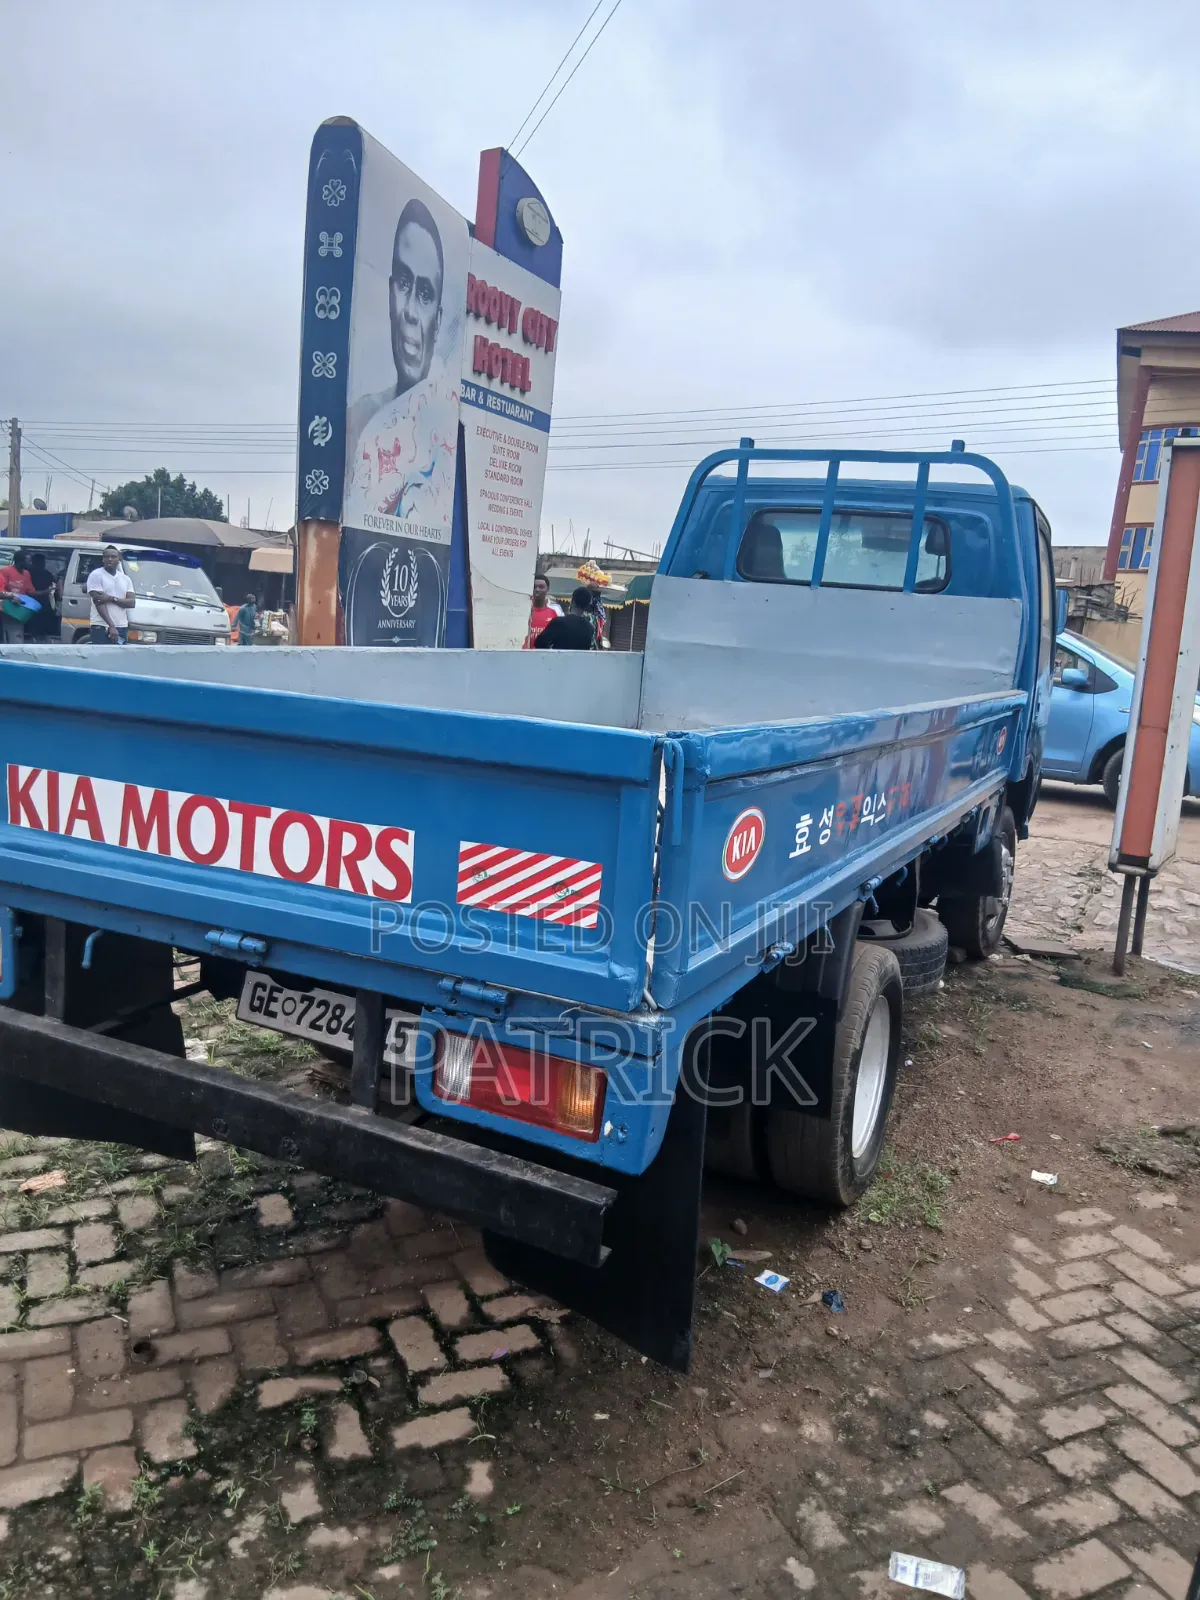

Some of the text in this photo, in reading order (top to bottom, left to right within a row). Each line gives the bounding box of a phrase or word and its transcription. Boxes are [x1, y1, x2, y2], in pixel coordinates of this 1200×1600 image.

[522, 307, 559, 352] CITY
[473, 335, 532, 392] HOTEL
[460, 385, 534, 423] BAR & RESTUARANT
[476, 426, 502, 442] EXECUTIVE
[508, 436, 525, 450] DOUBLE
[526, 441, 539, 454] ROOM
[492, 444, 520, 461] SUITE ROOM
[489, 457, 522, 474] DELUXE ROOM
[485, 469, 524, 487] STANDARD ROOM
[480, 489, 532, 508] SPACIOUS CONFERENCE HALL
[488, 504, 505, 515] WEDDING
[510, 508, 523, 518] EVENTS
[364, 514, 442, 540] FOREVER IN OUR HEARTS
[478, 522, 490, 532] LOCAL
[495, 525, 519, 536] CONTINENTAL
[520, 529, 532, 538] DISHES
[482, 535, 493, 544] MAKE
[494, 536, 504, 545] YOUR
[505, 538, 519, 547] ORDERS
[500, 549, 514, 558] EVENTS
[393, 565, 408, 592] 10
[391, 595, 408, 607] YEARS
[378, 620, 416, 629] ANNIVERSARY
[8, 764, 412, 902] KIA MOTORS
[732, 826, 756, 864] KIA
[249, 982, 284, 1019] GE
